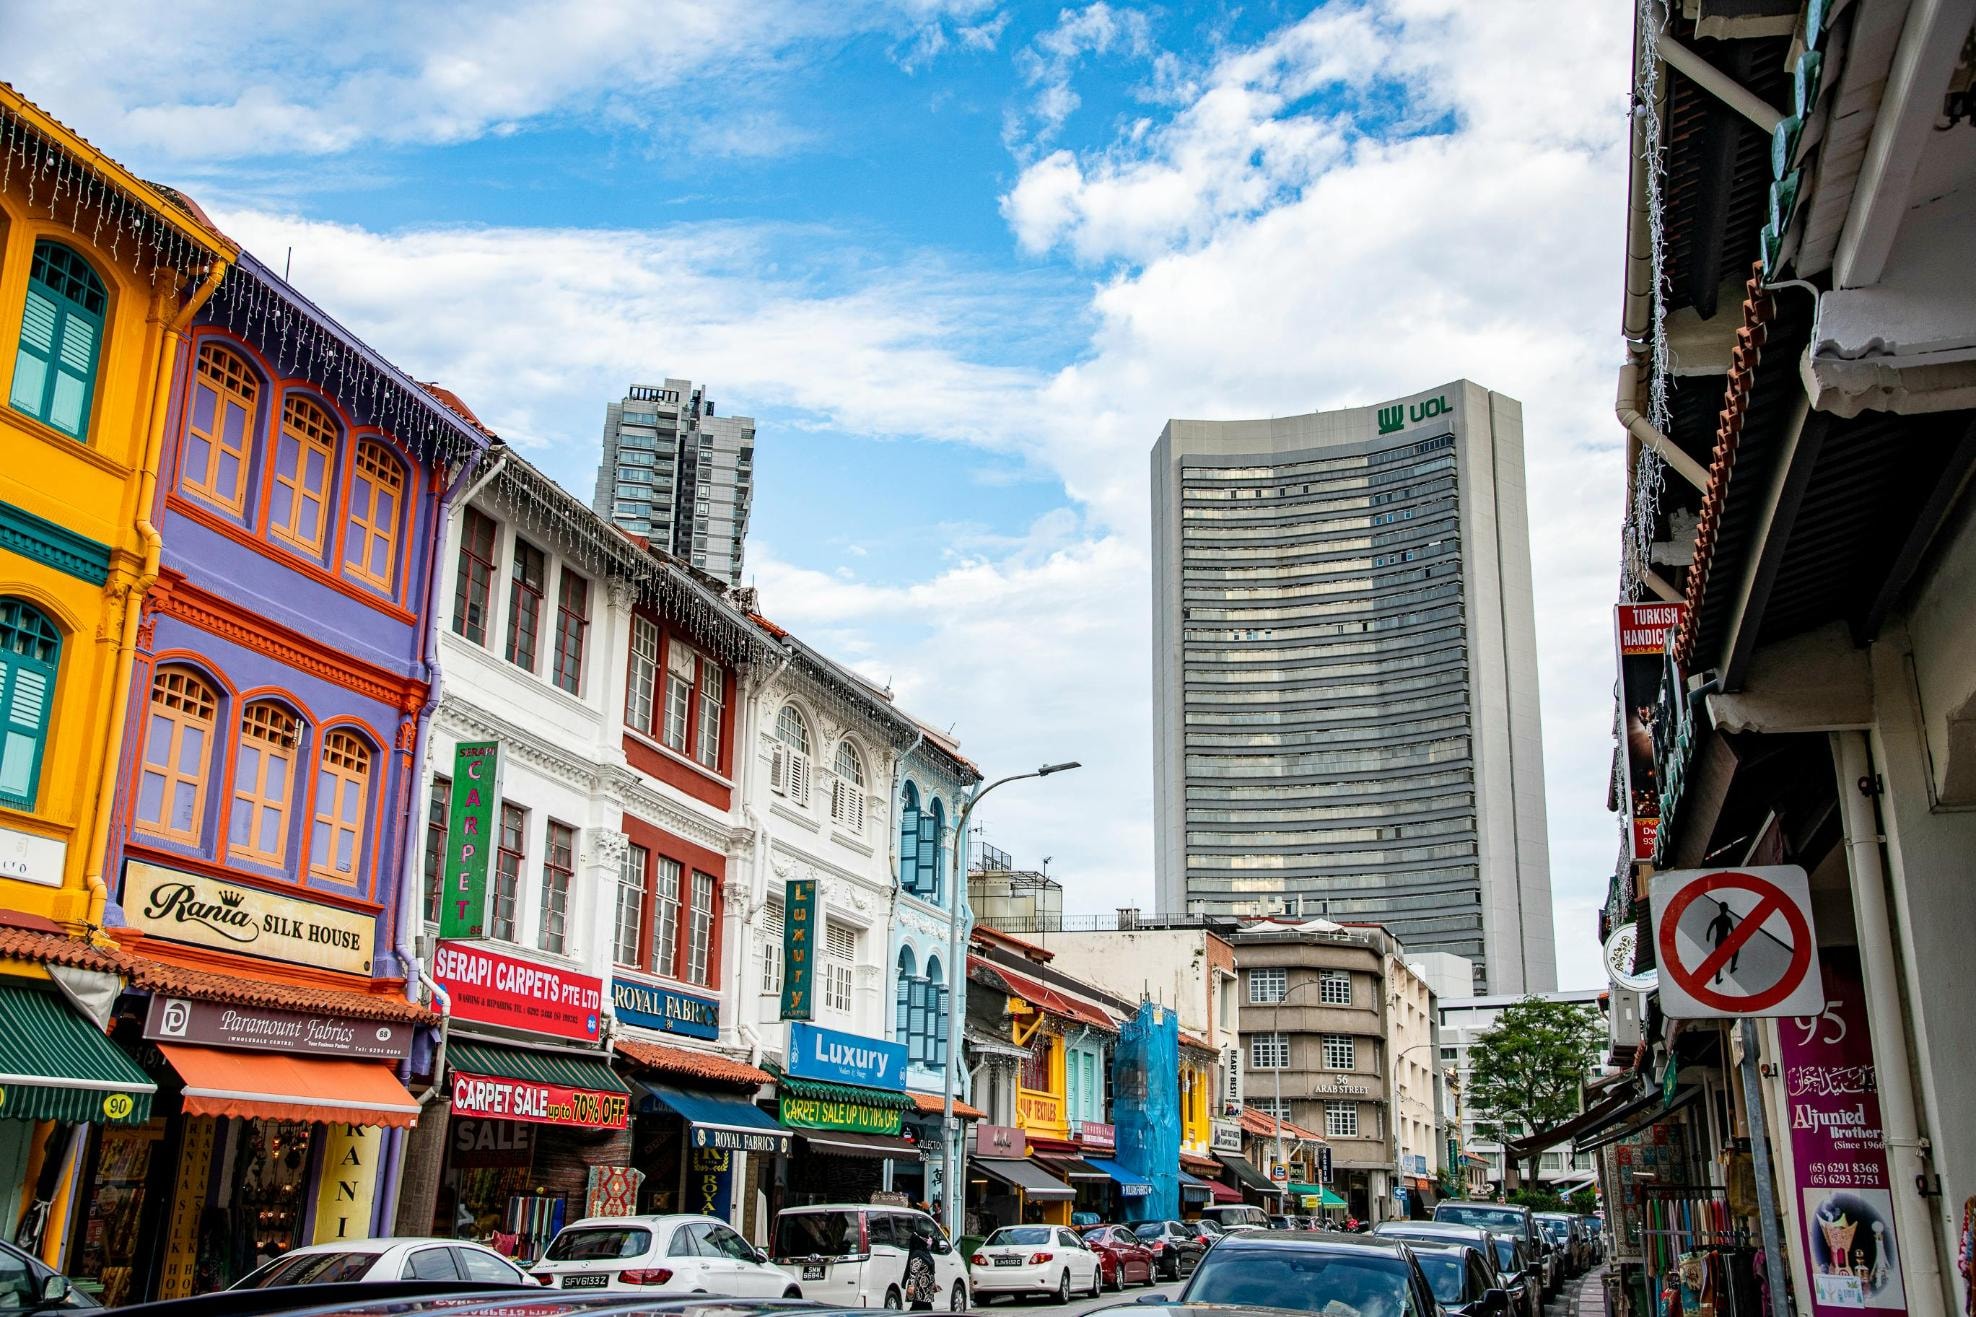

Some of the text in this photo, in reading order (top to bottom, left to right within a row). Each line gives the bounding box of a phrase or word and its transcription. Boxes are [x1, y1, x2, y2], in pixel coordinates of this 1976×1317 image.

[1409, 395, 1454, 423] UOL
[1633, 607, 1679, 625] TURKISH
[1623, 628, 1666, 646] HANDIC
[455, 760, 482, 921] CARPET
[144, 882, 361, 951] Rania SILK HOUSE
[436, 947, 599, 1011] SERAPI CARPETS PTE LTD
[614, 983, 663, 1016] ROYAL
[219, 1010, 355, 1043] Paramount Fabrics
[1794, 1000, 1847, 1046] 95
[815, 1033, 889, 1079] Luxury
[1230, 1049, 1238, 1075] BEARY
[1315, 1084, 1370, 1094] ARAB STREET
[1336, 1074, 1348, 1085] 56
[109, 1097, 128, 1115] 90
[455, 1078, 513, 1114] CARPET
[513, 1085, 549, 1118] SALE
[548, 1105, 561, 1122] up
[561, 1104, 571, 1119] to
[573, 1093, 599, 1124] 70%
[601, 1096, 627, 1125] OFF
[783, 1098, 900, 1129] CARPET SALE UP TO 70% OFF
[1792, 1103, 1867, 1133] Aljunied
[456, 1120, 530, 1151] SALE
[714, 1131, 742, 1149] ROYAL
[743, 1134, 775, 1152] FABRICS
[1834, 1140, 1861, 1150] (Since
[1809, 1162, 1879, 1174] (65) 6291 8368
[1810, 1174, 1880, 1186] (65) 6293 2751
[563, 1275, 607, 1287] SFV6133Z
